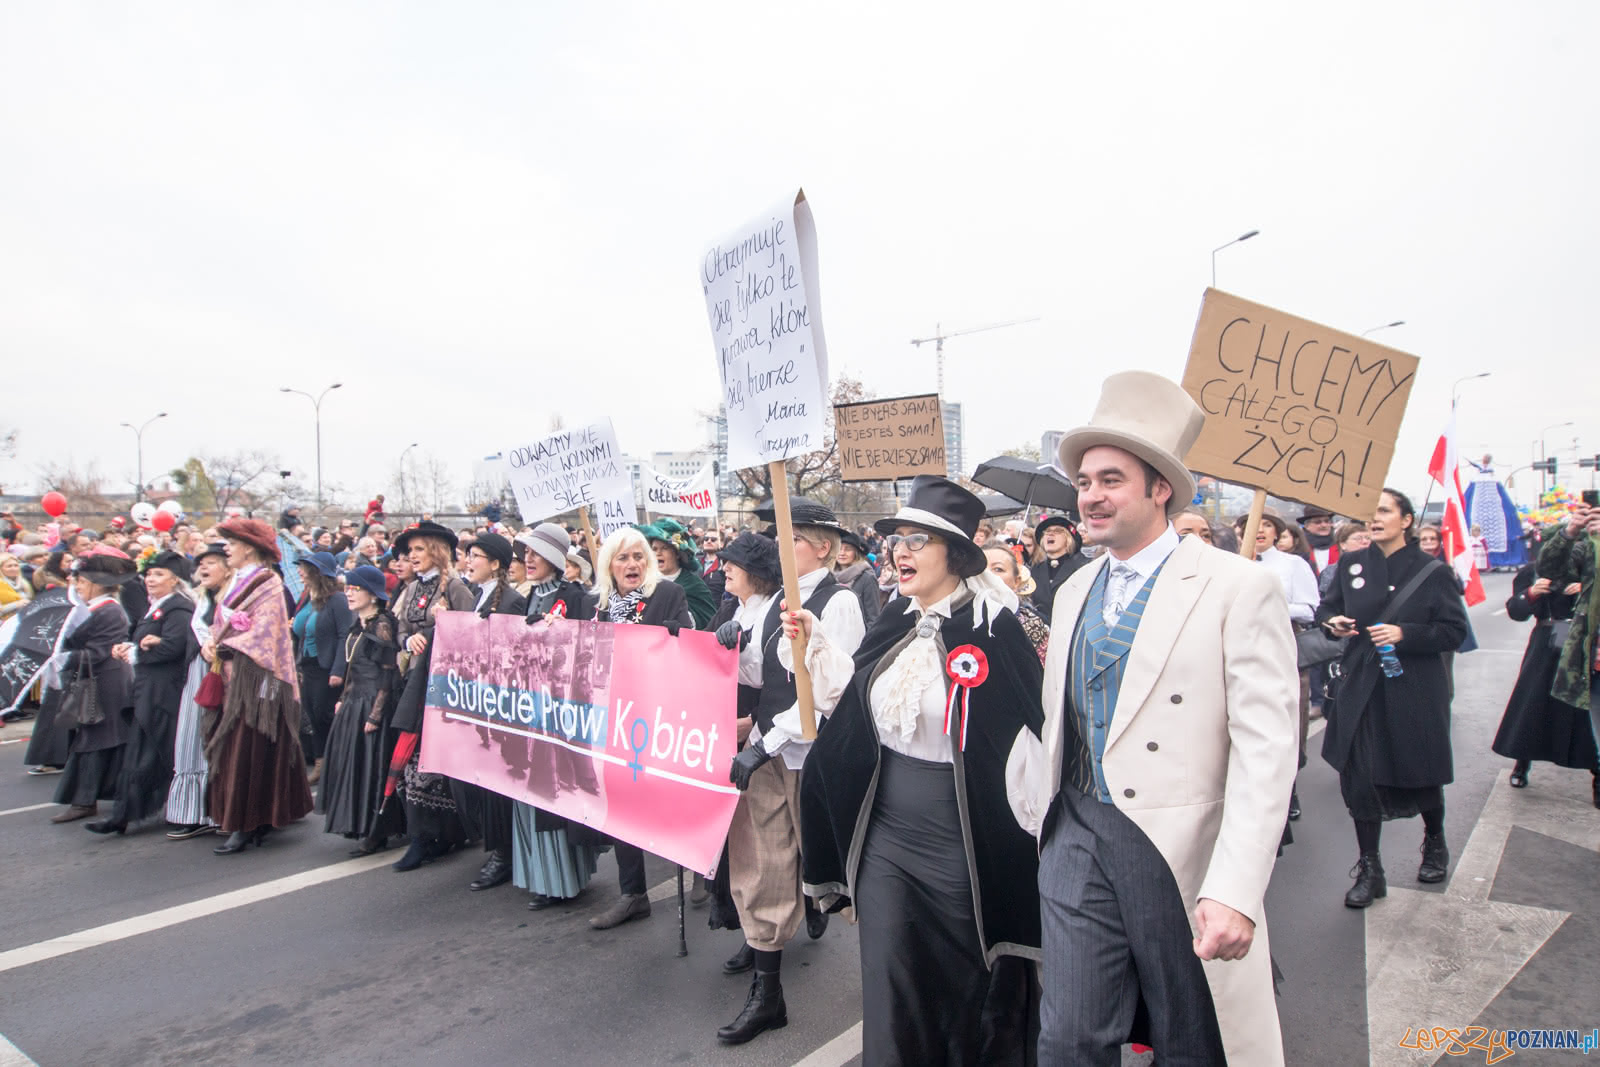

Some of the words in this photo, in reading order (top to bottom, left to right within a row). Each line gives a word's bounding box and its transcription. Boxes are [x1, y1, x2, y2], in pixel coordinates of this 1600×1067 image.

[737, 272, 774, 323] tylko
[780, 253, 798, 291] te
[1218, 317, 1414, 426] CHCEMY
[765, 396, 807, 423] Maria
[838, 406, 859, 426] NIE
[1200, 378, 1338, 446] CAŁEGO
[560, 441, 612, 472] WOLNYMI
[842, 447, 865, 469] NIE
[917, 446, 944, 467] SAMA
[604, 500, 624, 518] DLA
[446, 668, 534, 723] Stulecie
[541, 684, 605, 742] Praw
[612, 698, 719, 774] Kobiet
